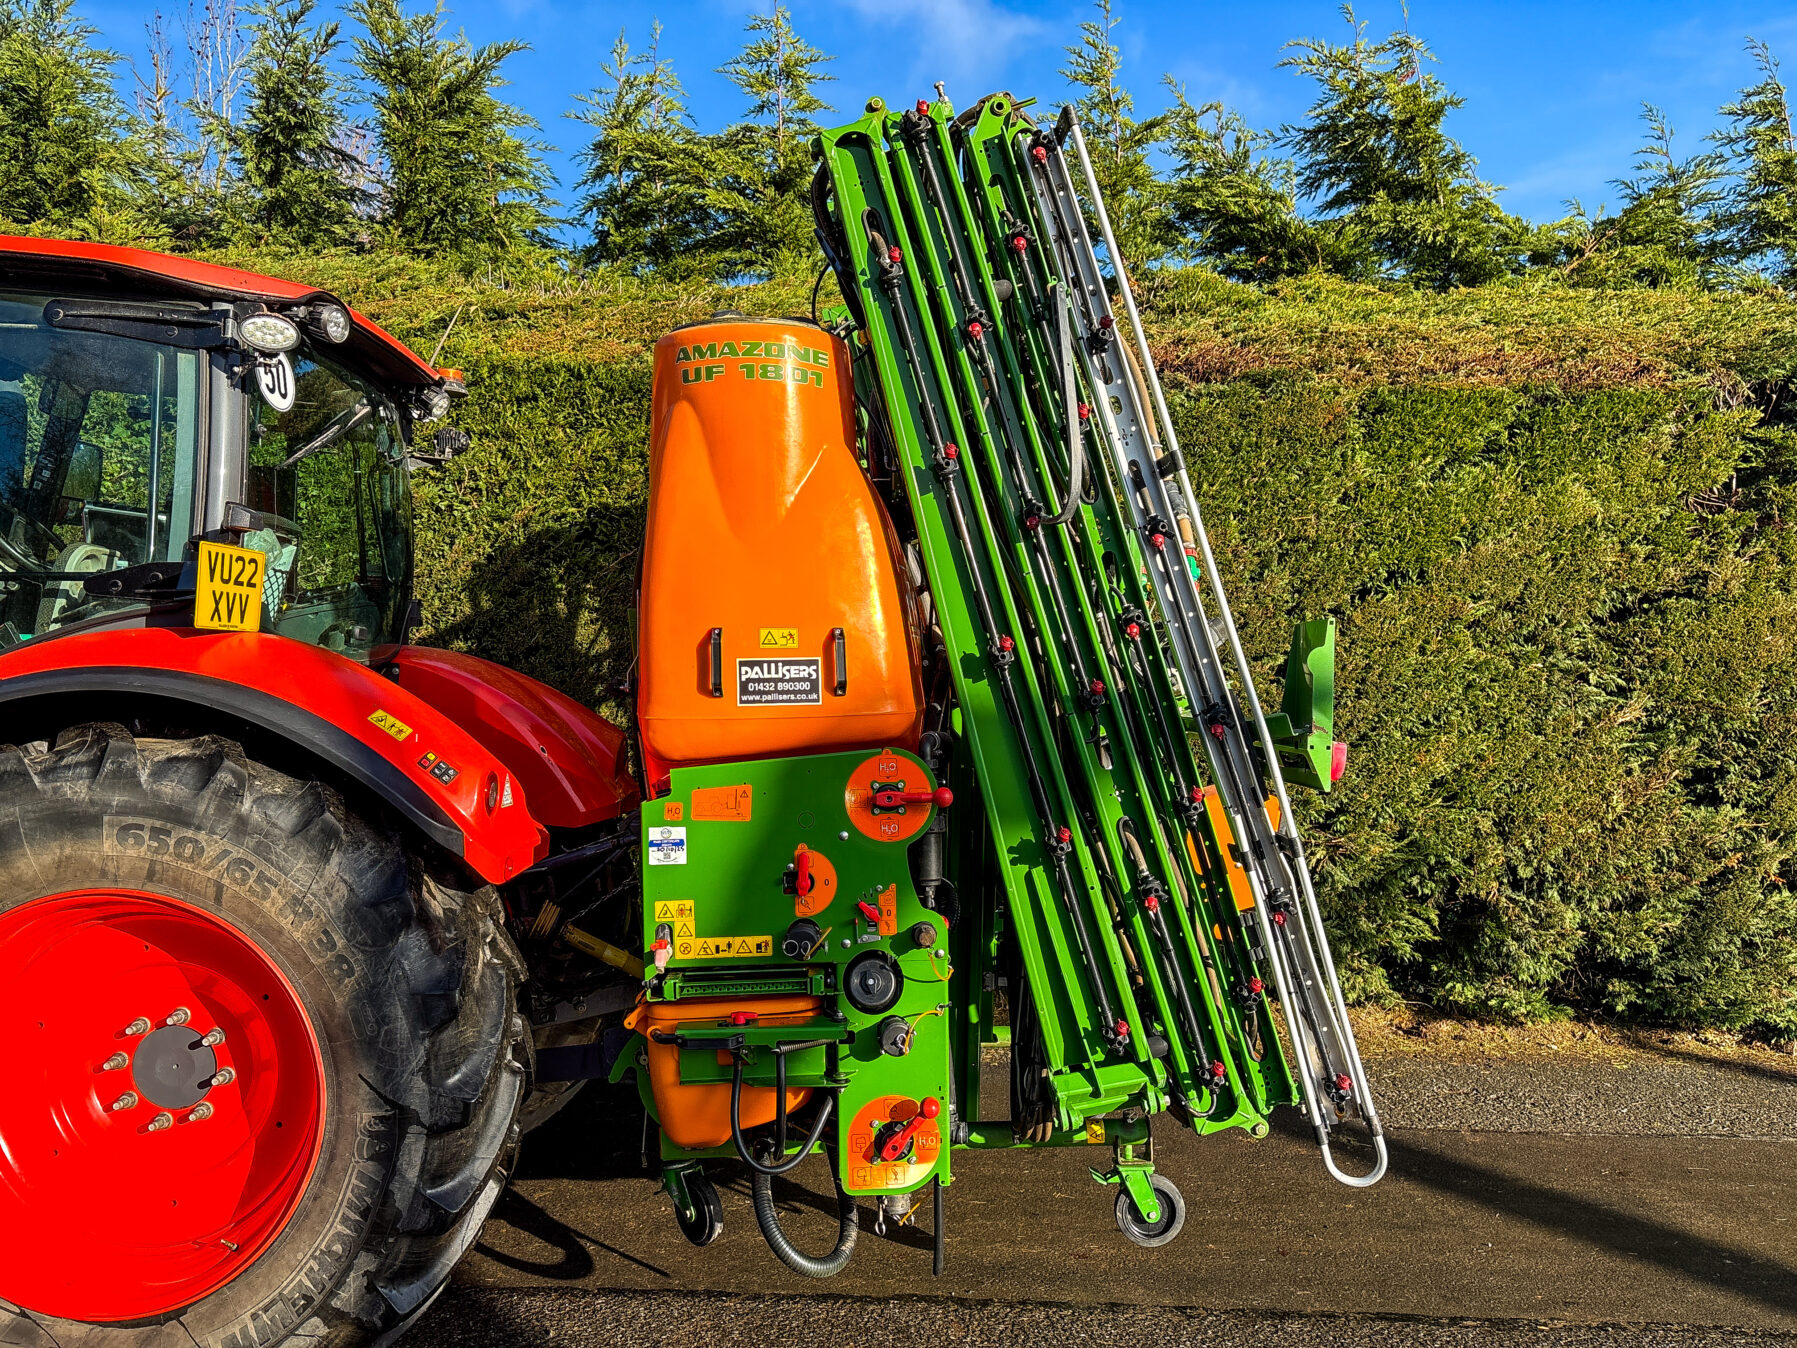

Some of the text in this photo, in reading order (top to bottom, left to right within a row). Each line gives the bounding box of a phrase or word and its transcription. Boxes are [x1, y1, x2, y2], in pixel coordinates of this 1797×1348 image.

[676, 341, 829, 368] AMAZONE
[264, 358, 288, 400] 50
[681, 363, 824, 388] UF 1801
[208, 550, 258, 589] VU22
[210, 589, 250, 624] XVV
[741, 693, 818, 702] www.pallisers.co.uk
[748, 682, 811, 691] 01432 890300
[116, 822, 281, 901] 650/65
[307, 927, 357, 980] 38
